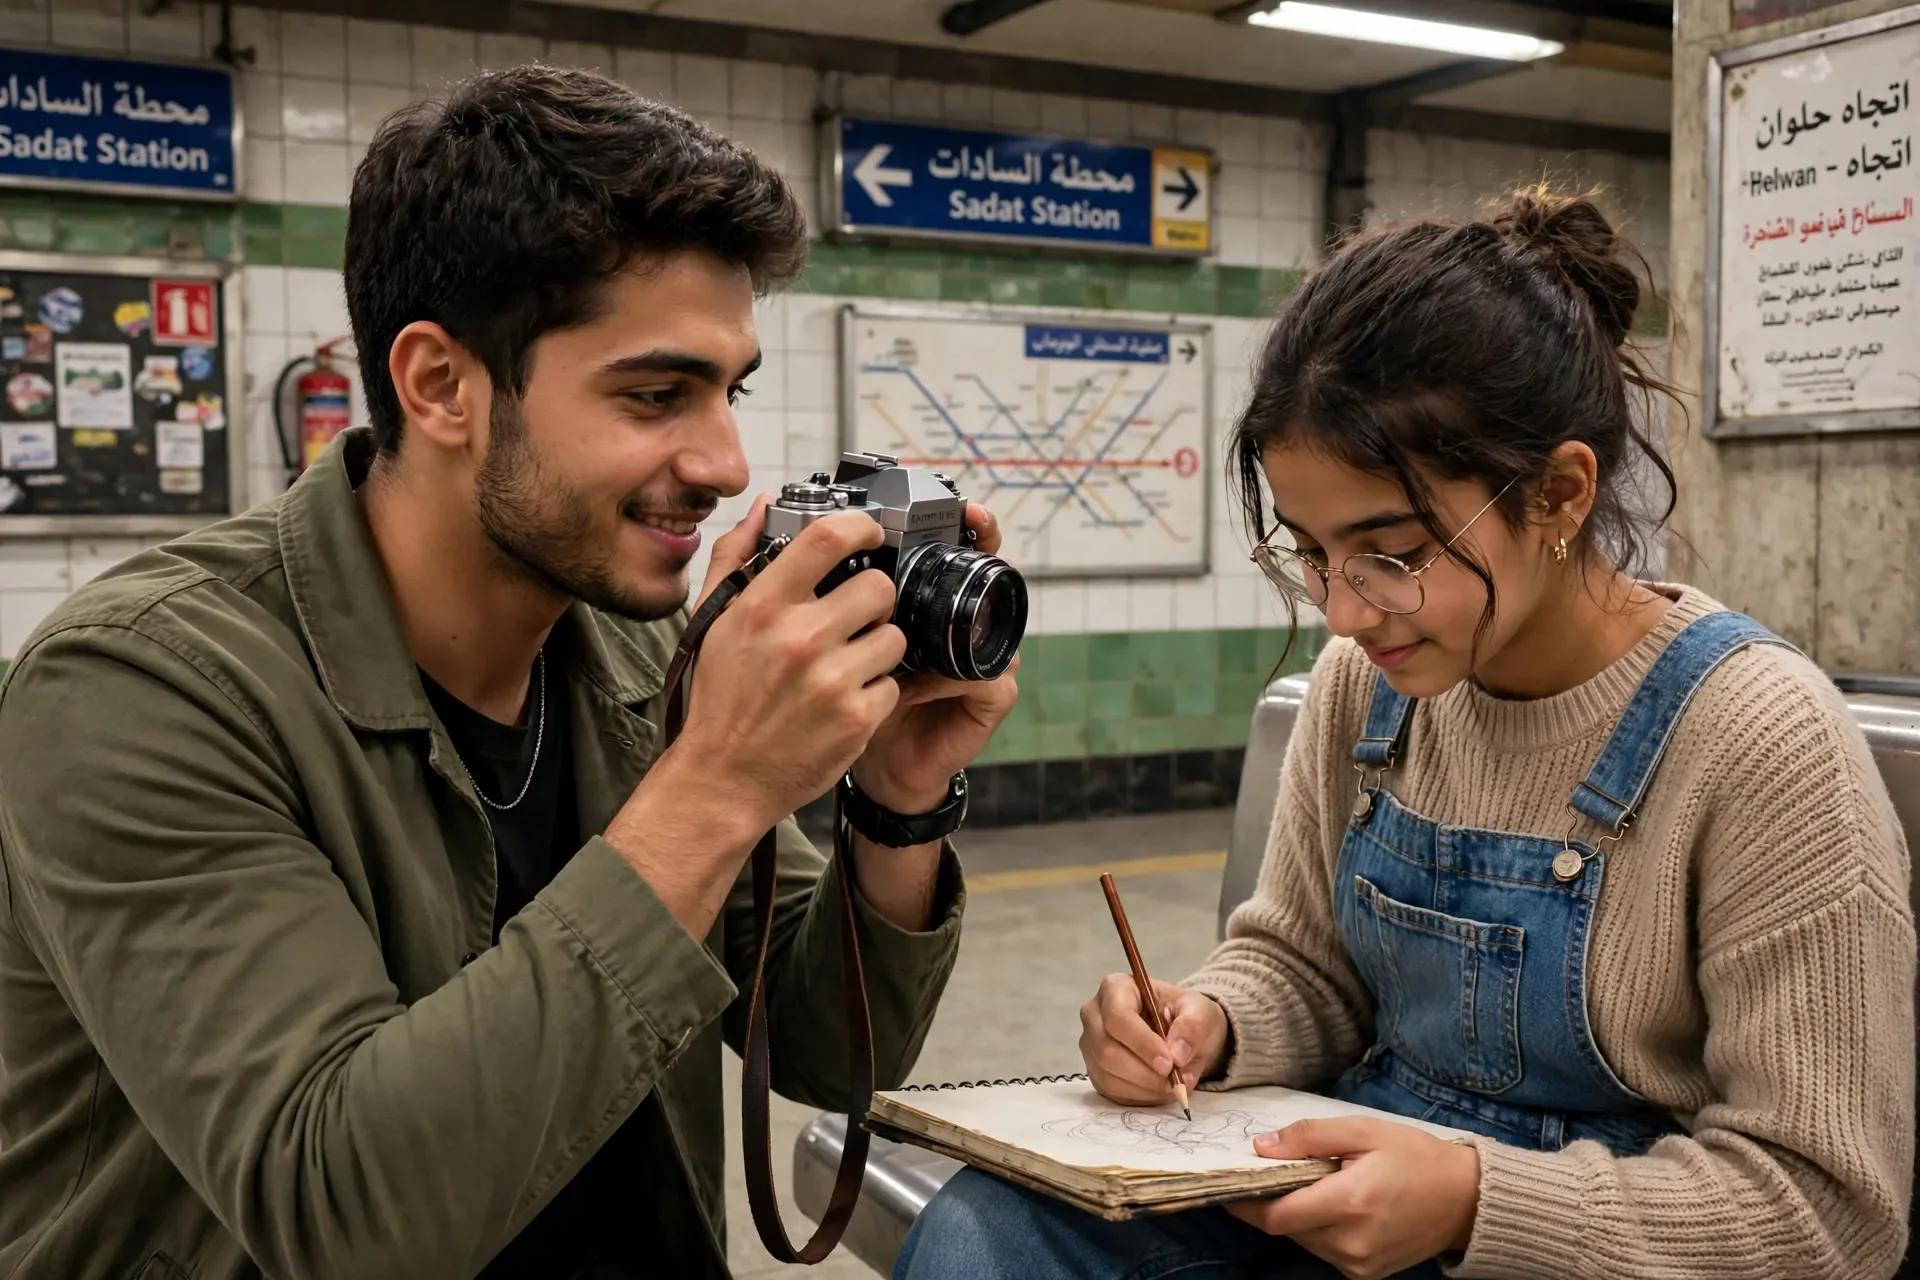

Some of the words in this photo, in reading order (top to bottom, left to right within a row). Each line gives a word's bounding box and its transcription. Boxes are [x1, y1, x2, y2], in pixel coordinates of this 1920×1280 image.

[0, 74, 102, 116] السادا
[113, 81, 209, 124] محطة
[1842, 79, 1909, 128] اتجاه
[1756, 101, 1831, 149] حلوان
[0, 125, 88, 163] Sadat
[97, 133, 209, 172] Station
[928, 145, 1042, 184] السادات
[1847, 135, 1911, 181] اتجاه
[1049, 153, 1135, 193] محطة
[1750, 165, 1817, 197] Helwan
[949, 190, 1024, 224] Sadat
[1031, 196, 1120, 231] Station
